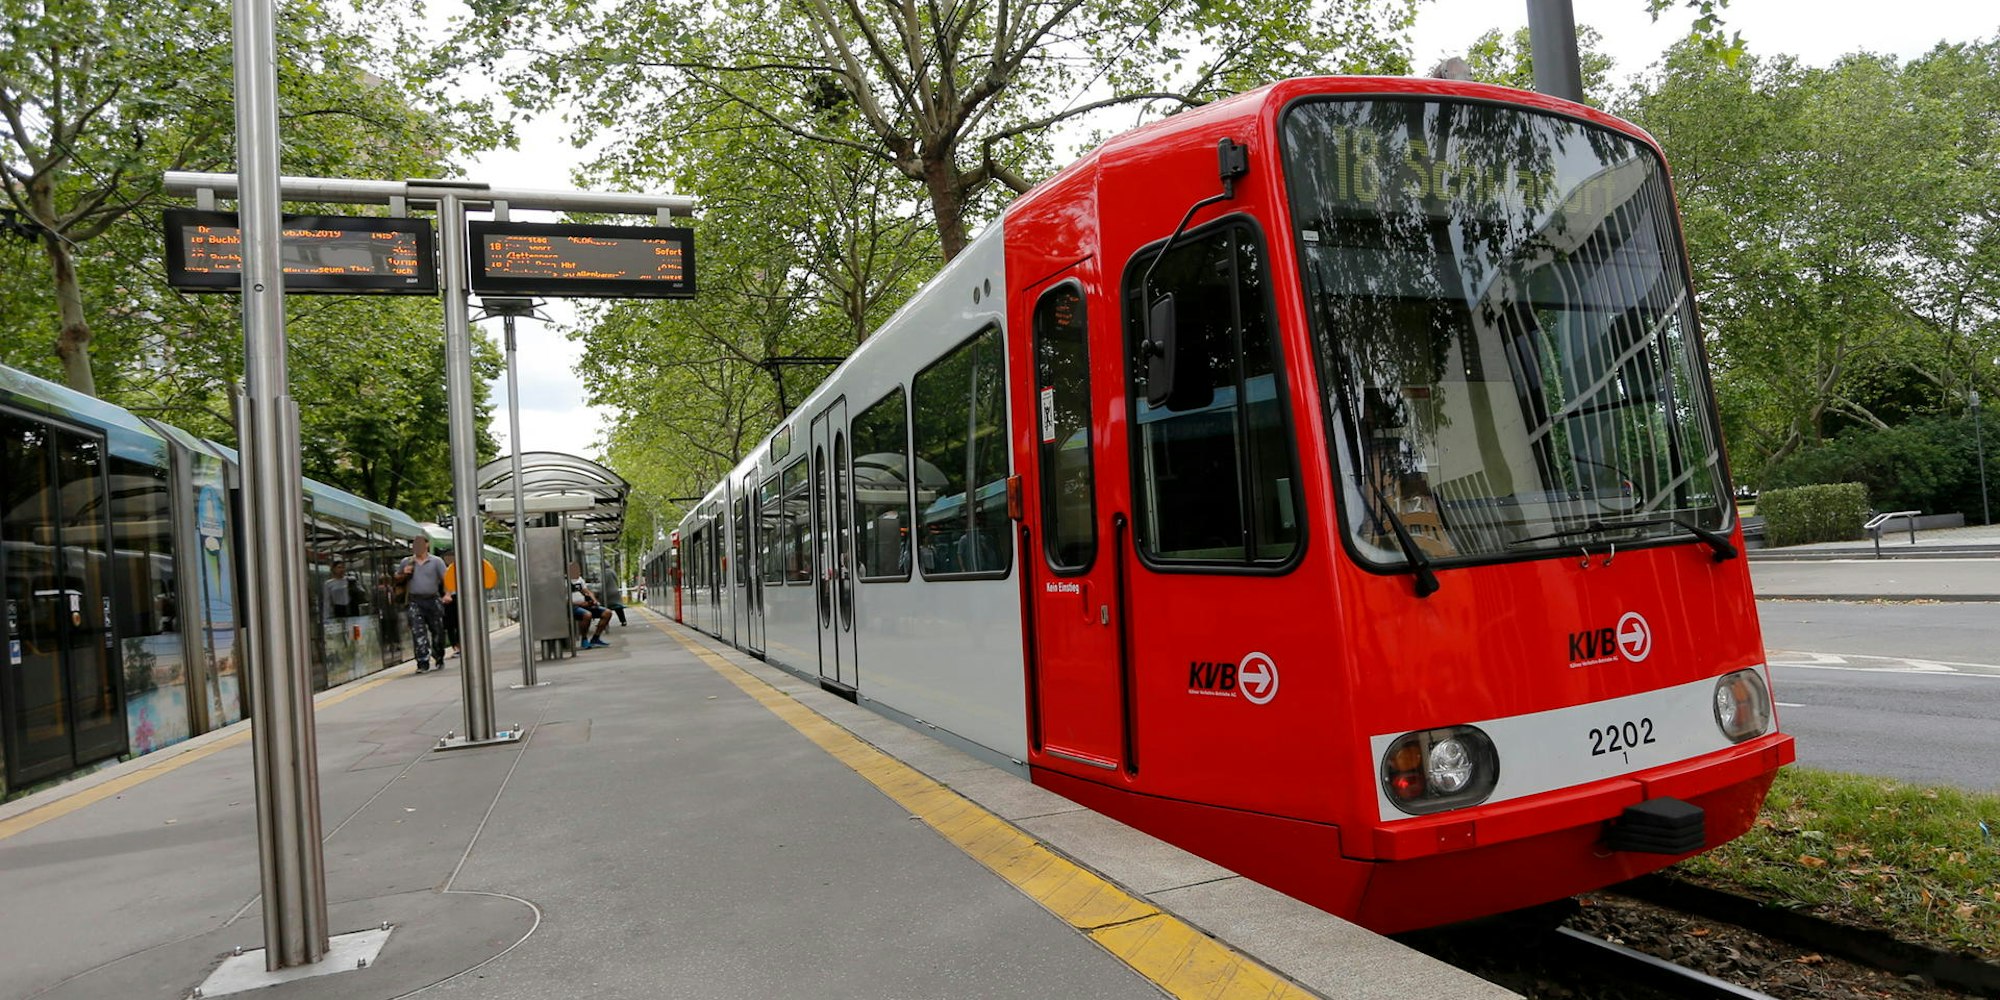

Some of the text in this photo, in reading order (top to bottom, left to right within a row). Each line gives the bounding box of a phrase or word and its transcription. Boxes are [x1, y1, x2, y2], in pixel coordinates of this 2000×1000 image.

[1333, 124, 1381, 203] 18
[655, 247, 683, 256] Sofort
[1569, 627, 1616, 661] KVB
[1189, 661, 1237, 690] KVB
[1589, 717, 1656, 756] 2202
